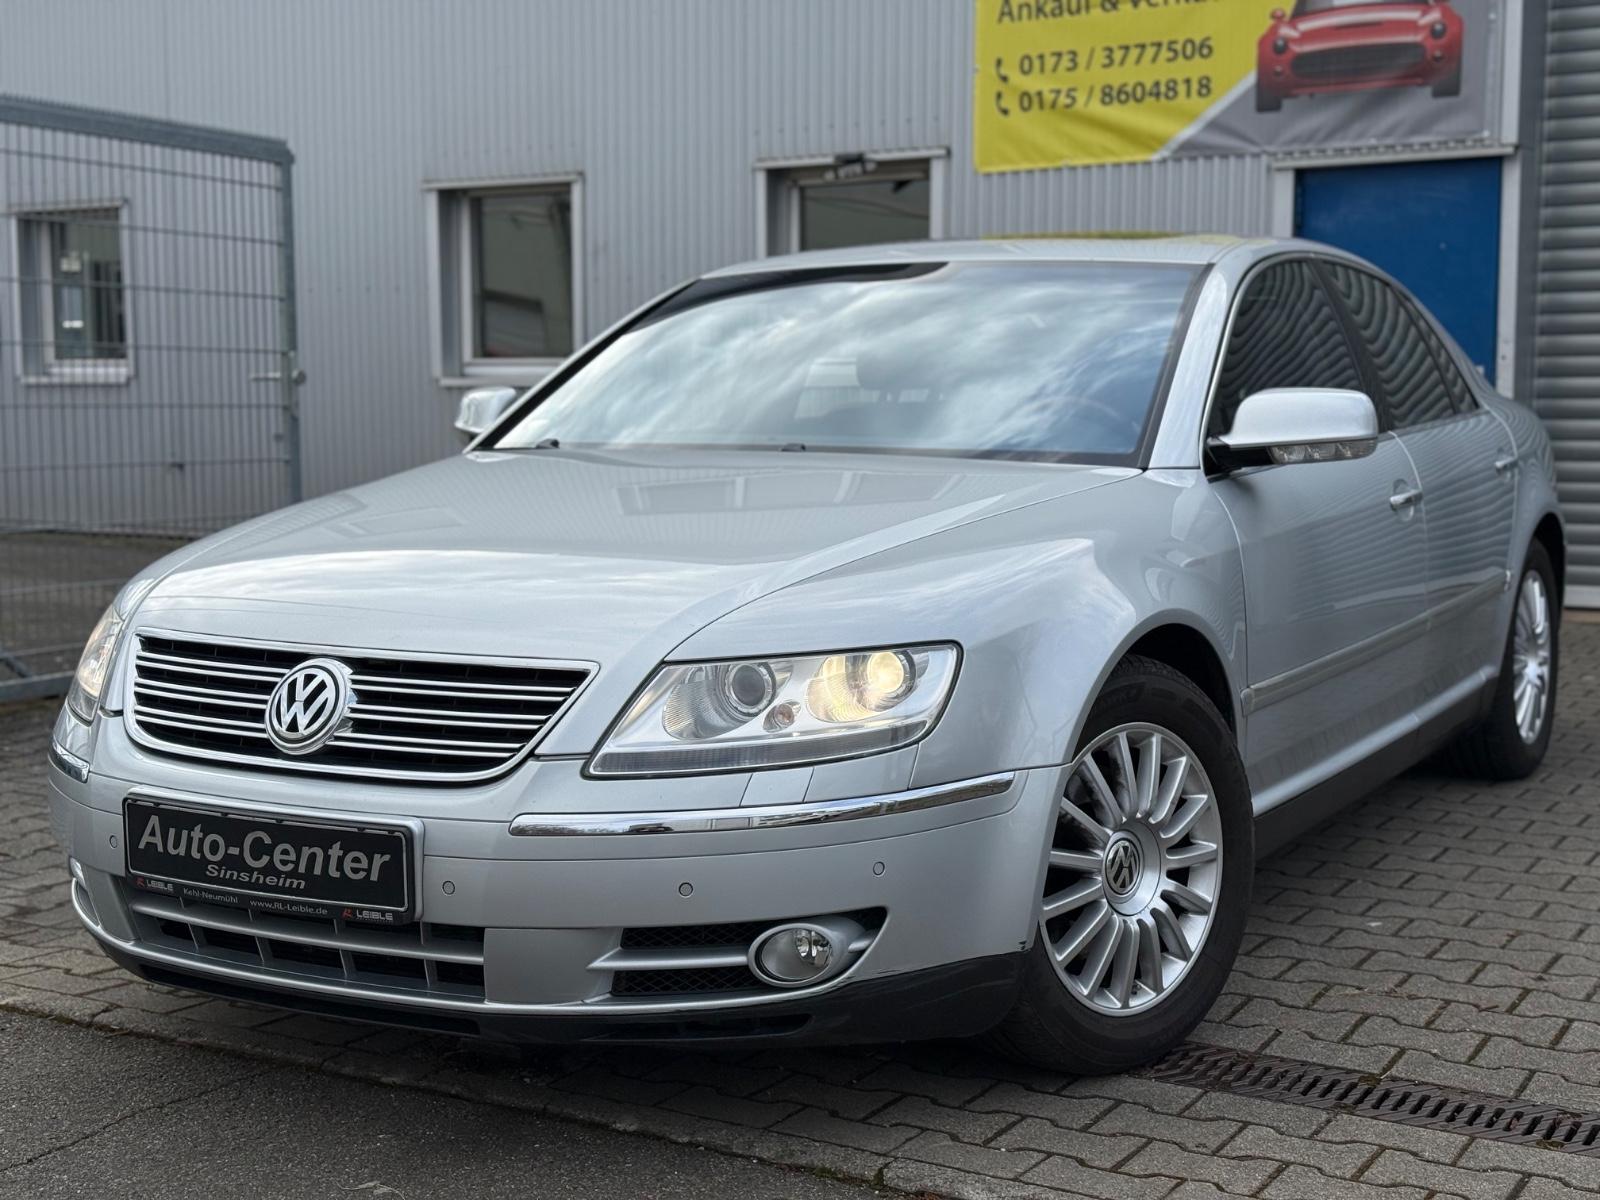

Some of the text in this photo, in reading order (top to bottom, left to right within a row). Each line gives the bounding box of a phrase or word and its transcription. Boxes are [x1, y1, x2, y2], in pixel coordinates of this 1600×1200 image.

[1019, 36, 1214, 76] 0173 / 3777506
[1018, 75, 1212, 112] 0175 / 8604818
[137, 814, 393, 882] Auto-Center
[205, 863, 306, 889] Sinsheim
[183, 887, 328, 915] Kehl-Neumühl www.RL-Leible.de
[356, 908, 393, 921] LEIBLE
